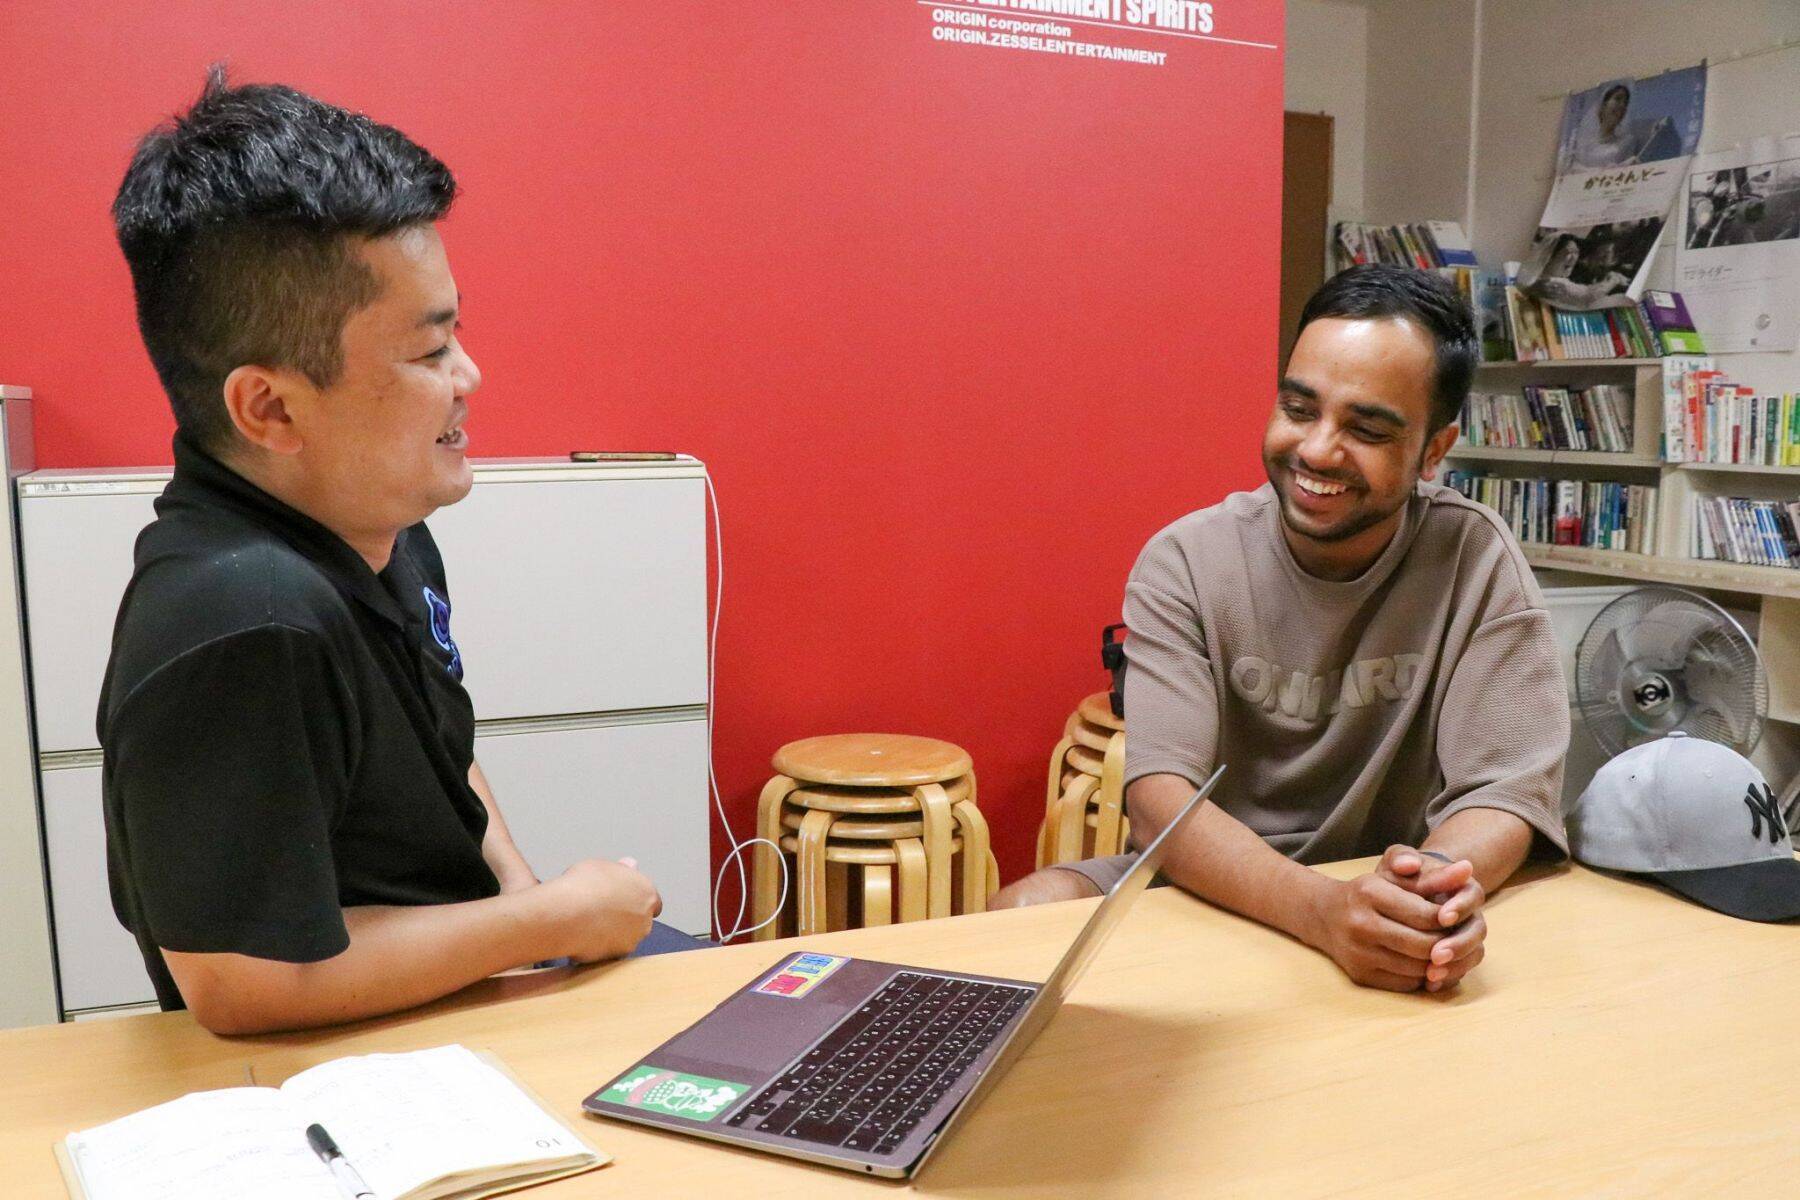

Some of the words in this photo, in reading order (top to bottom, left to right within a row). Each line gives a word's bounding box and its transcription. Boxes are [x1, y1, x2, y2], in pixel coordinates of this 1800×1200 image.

[932, 9, 987, 27] ORIGIN
[988, 17, 1072, 37] corporation
[1126, 0, 1213, 33] SPIRITS
